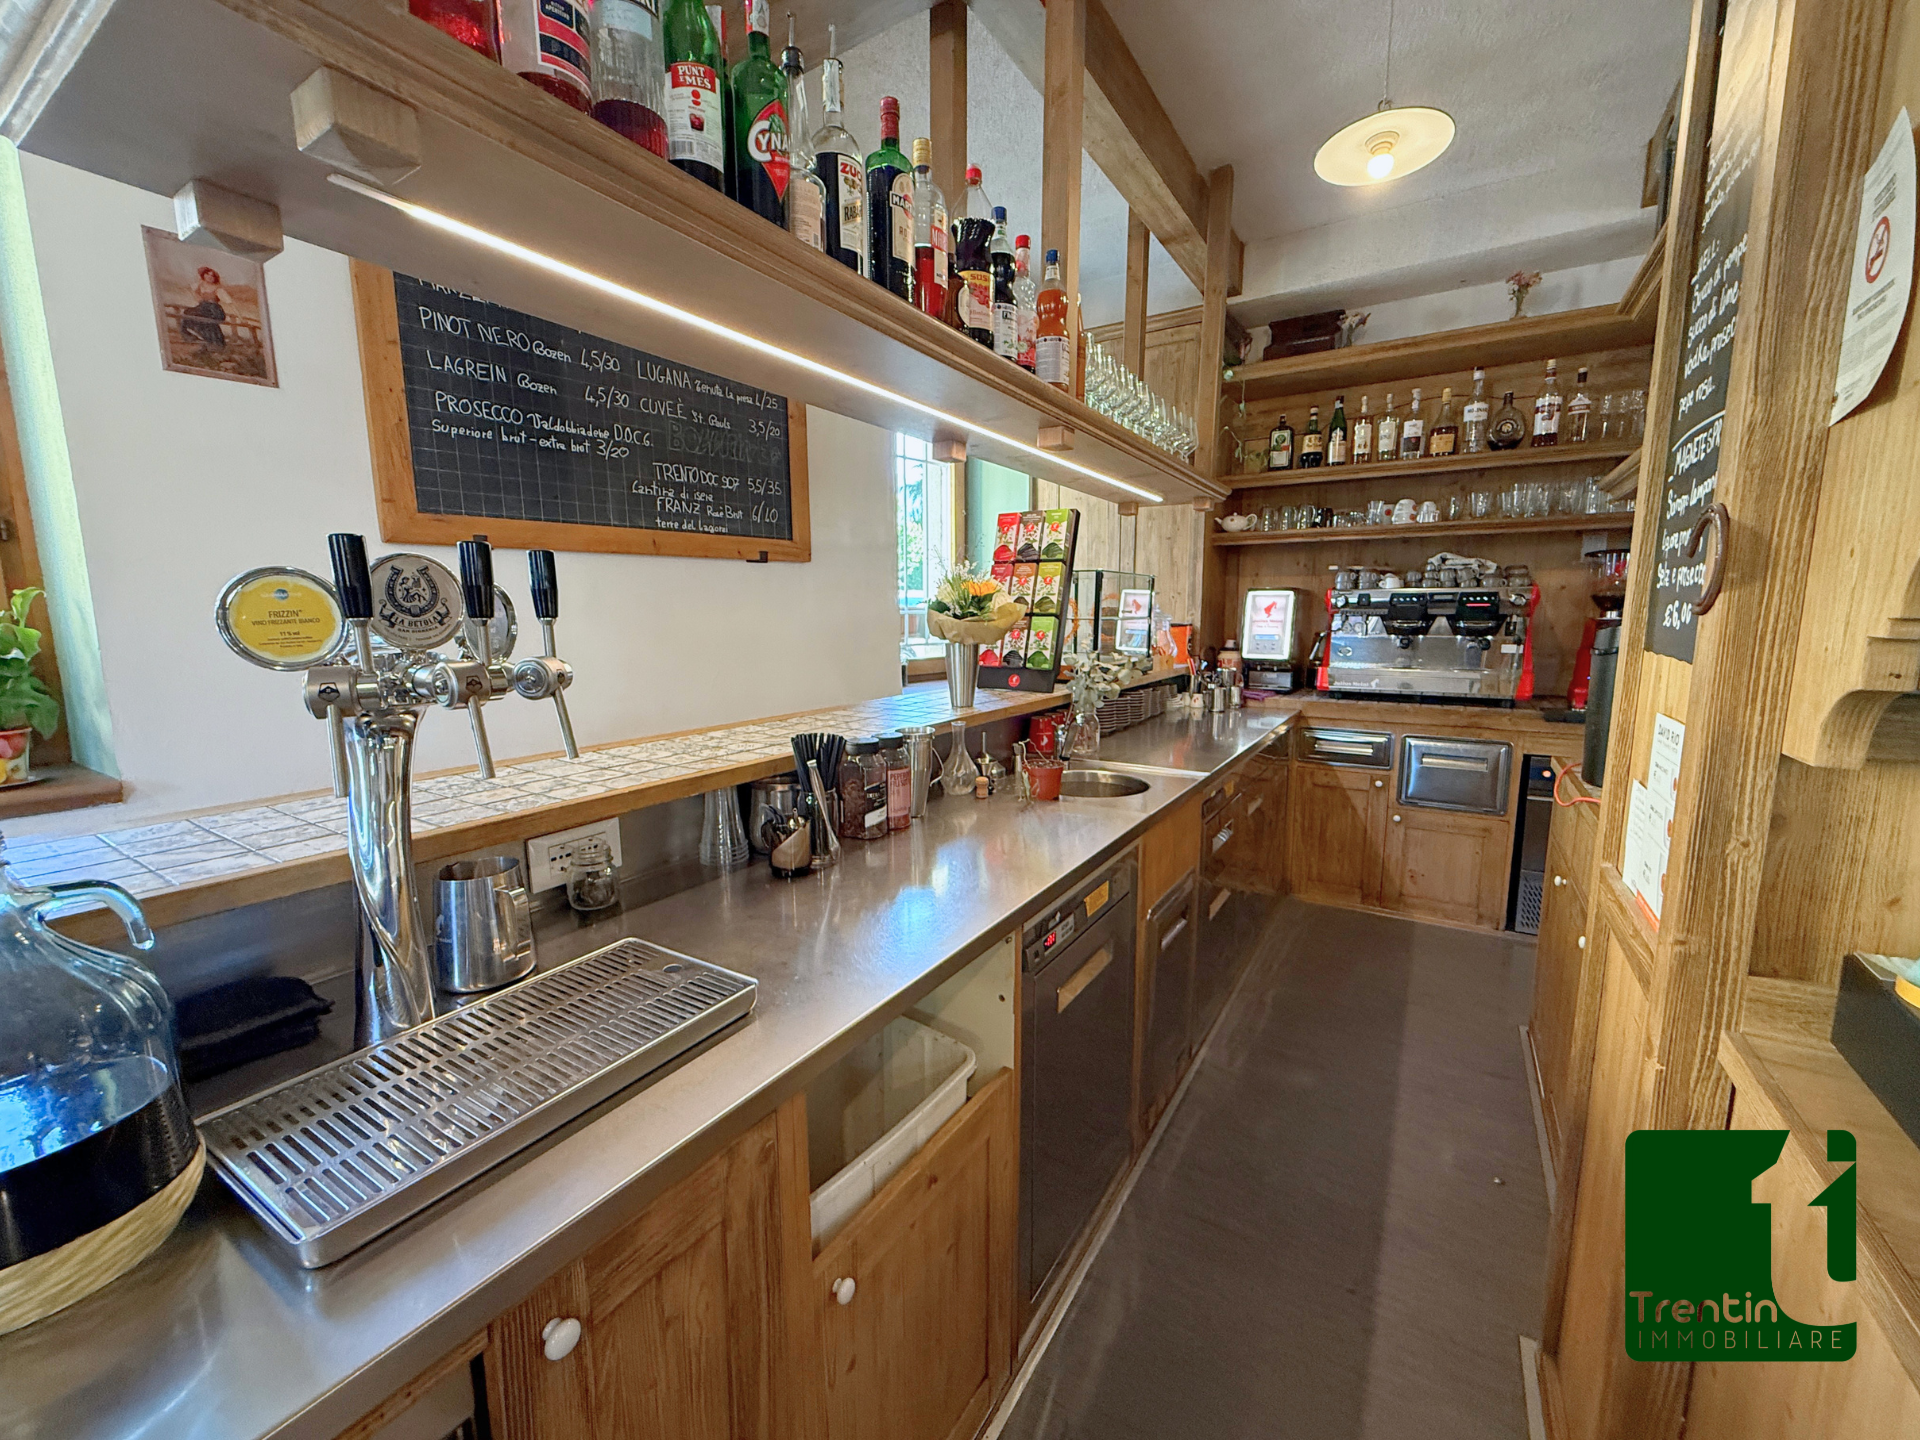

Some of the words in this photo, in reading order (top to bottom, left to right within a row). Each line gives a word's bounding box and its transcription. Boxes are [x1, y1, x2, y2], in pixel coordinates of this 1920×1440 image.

[677, 65, 705, 77] PUNT
[685, 76, 712, 89] MES
[418, 306, 471, 339] PINOT
[477, 322, 530, 352] NERO
[532, 340, 572, 364] Bozen
[427, 350, 508, 383] LAGREIN
[517, 373, 558, 396] Bozen
[636, 360, 692, 390] LUGANA
[434, 390, 524, 426] PROSECCO
[431, 418, 493, 440] Superiore
[596, 439, 630, 460] 3/20
[631, 480, 675, 498] Cantina
[680, 485, 689, 500] di
[656, 497, 700, 515] FRANZ
[655, 516, 679, 530] terre
